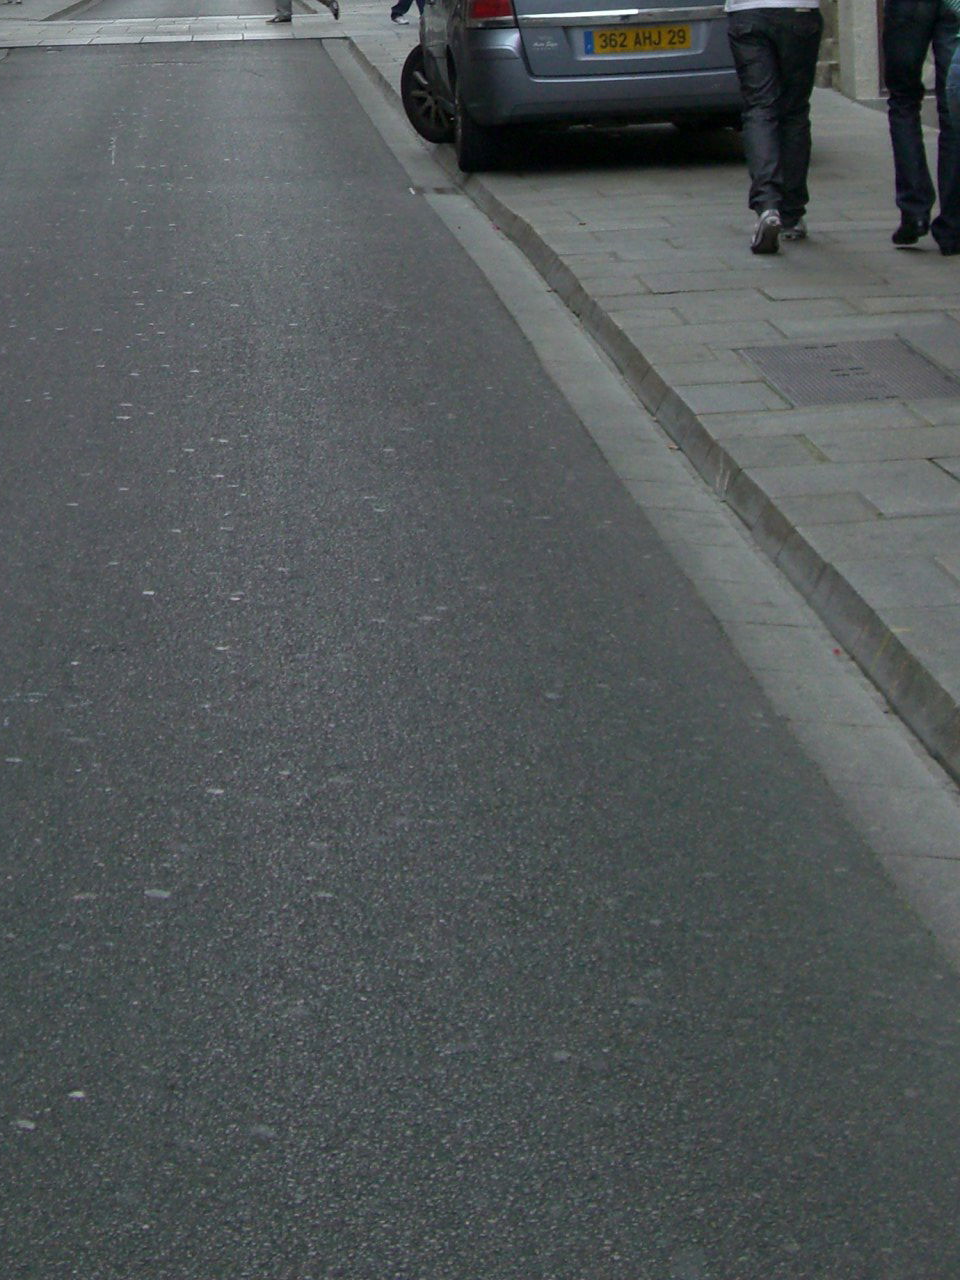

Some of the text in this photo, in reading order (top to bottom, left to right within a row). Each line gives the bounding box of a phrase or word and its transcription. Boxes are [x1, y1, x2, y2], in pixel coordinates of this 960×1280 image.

[599, 28, 686, 49] 362 AHJ 29
